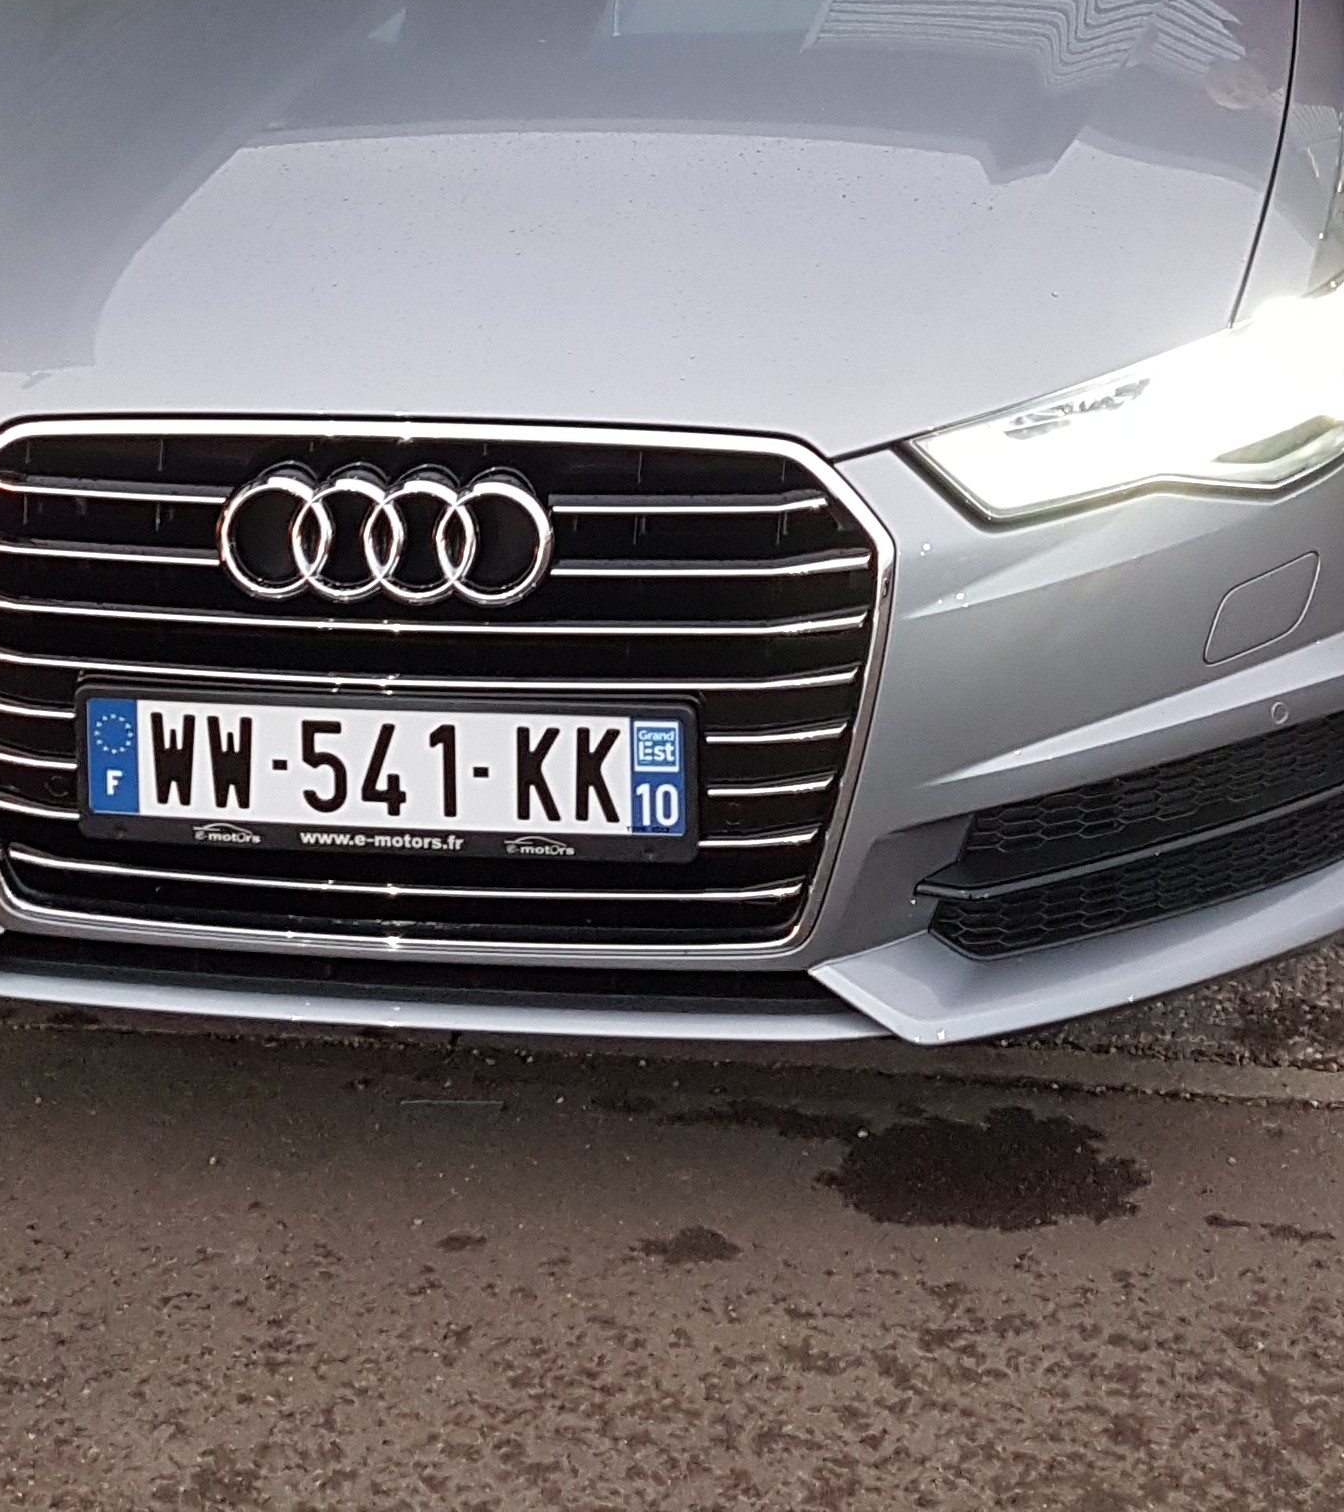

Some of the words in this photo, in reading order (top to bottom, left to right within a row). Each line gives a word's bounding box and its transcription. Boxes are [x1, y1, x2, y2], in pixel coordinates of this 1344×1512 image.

[638, 730, 675, 742] Grand
[638, 741, 676, 761] Est
[106, 769, 123, 796] F
[636, 782, 679, 826] 10
[299, 831, 465, 850] www.e-motors.fr
